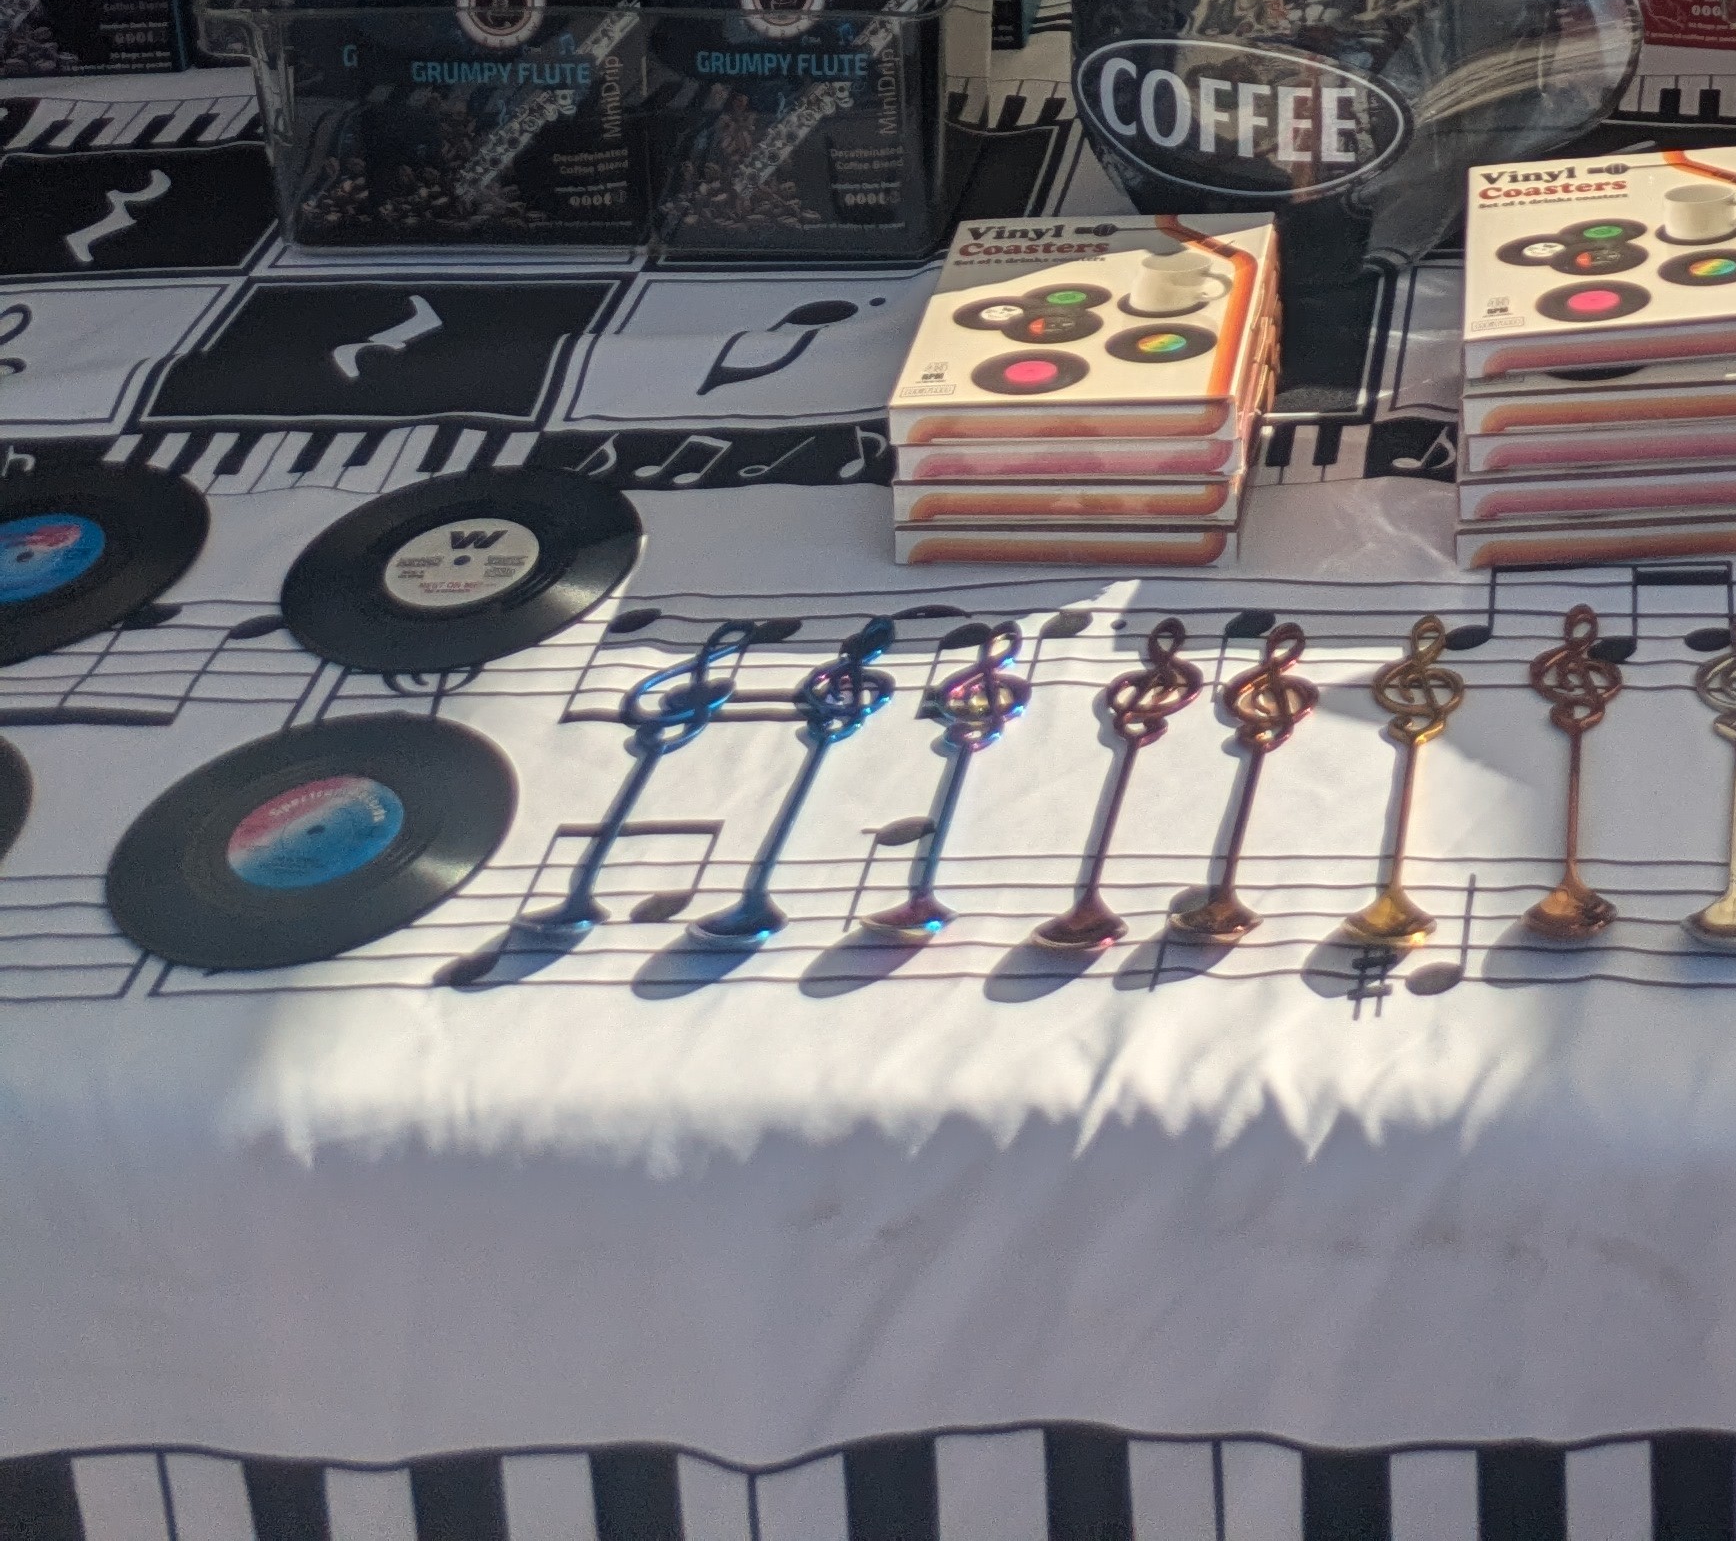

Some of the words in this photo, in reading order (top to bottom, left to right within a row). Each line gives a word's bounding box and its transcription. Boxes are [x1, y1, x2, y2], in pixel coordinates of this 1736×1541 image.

[410, 61, 513, 84] GRUMPY
[518, 63, 592, 84] FLUTE
[696, 51, 792, 75] GRUMPY
[797, 53, 868, 76] FLUTE
[603, 55, 624, 139] MiniDrip
[877, 48, 899, 135] MiniDrip
[1100, 57, 1357, 163] COFFEE
[1480, 166, 1576, 184] Vinyl
[1479, 180, 1627, 199] Coasters
[1529, 197, 1572, 205] drinks
[1575, 193, 1628, 201] coasters
[968, 225, 1065, 241] Vinyl
[959, 242, 1109, 256] Coasters
